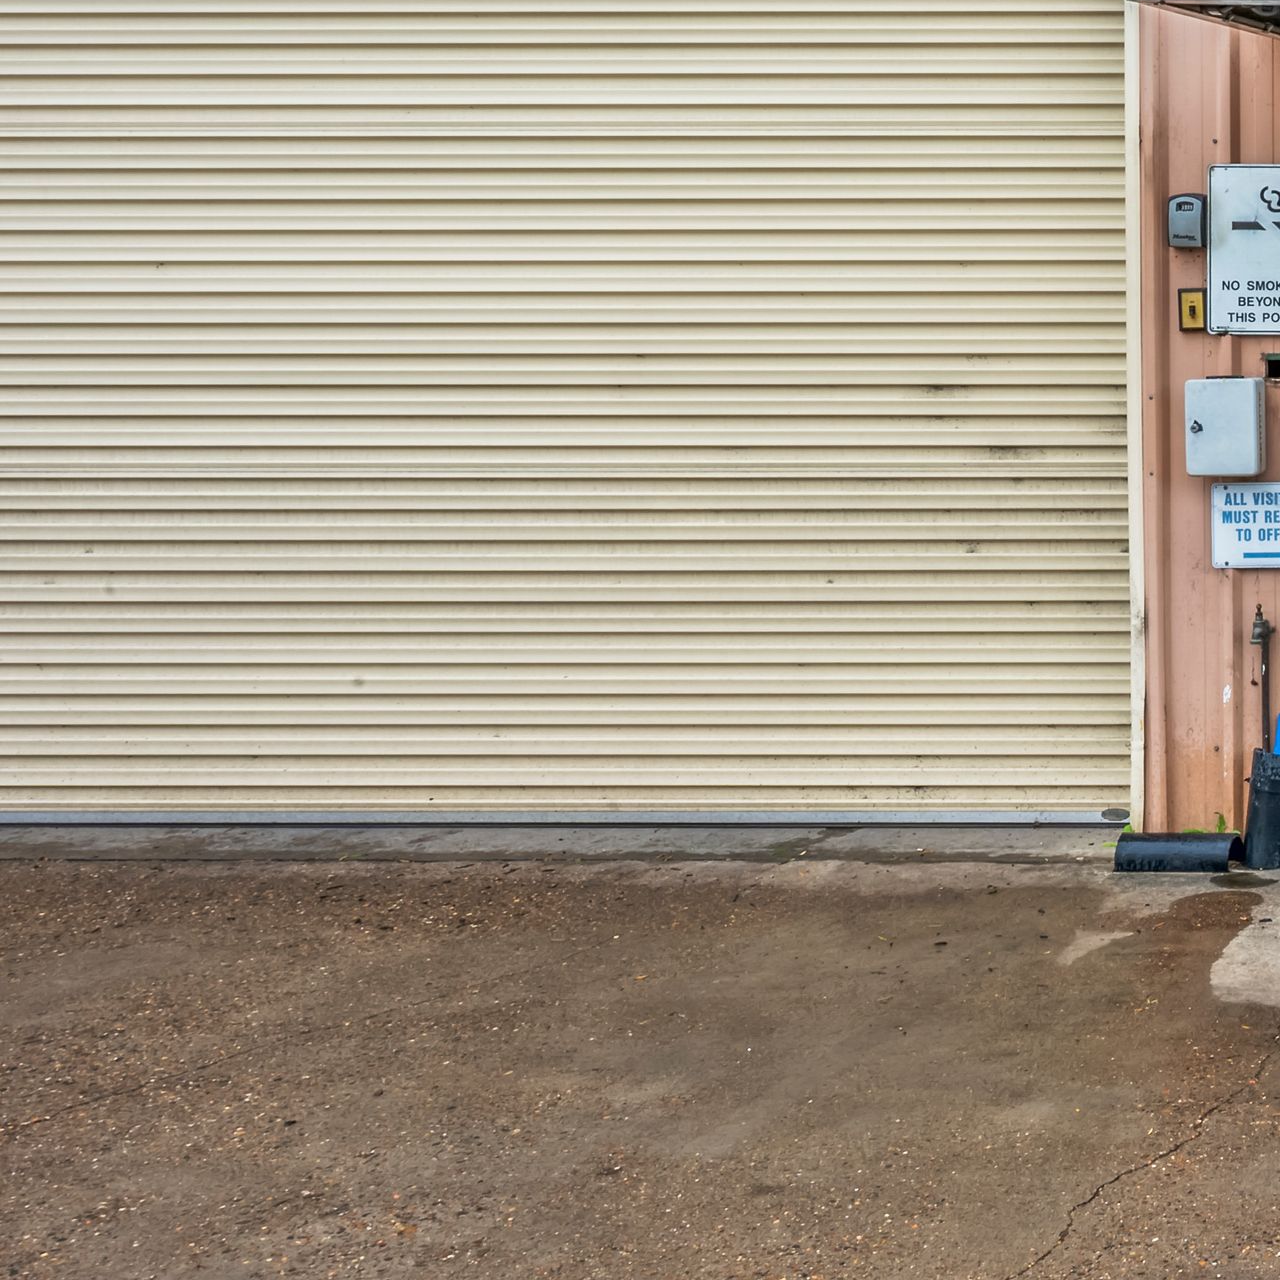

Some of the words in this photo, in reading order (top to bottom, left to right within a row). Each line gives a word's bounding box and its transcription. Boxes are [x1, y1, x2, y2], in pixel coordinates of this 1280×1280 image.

[1222, 280, 1240, 291] NO
[1227, 312, 1256, 323] THIS
[1224, 492, 1247, 506] ALL
[1222, 510, 1258, 524] MUST
[1236, 528, 1252, 542] TO
